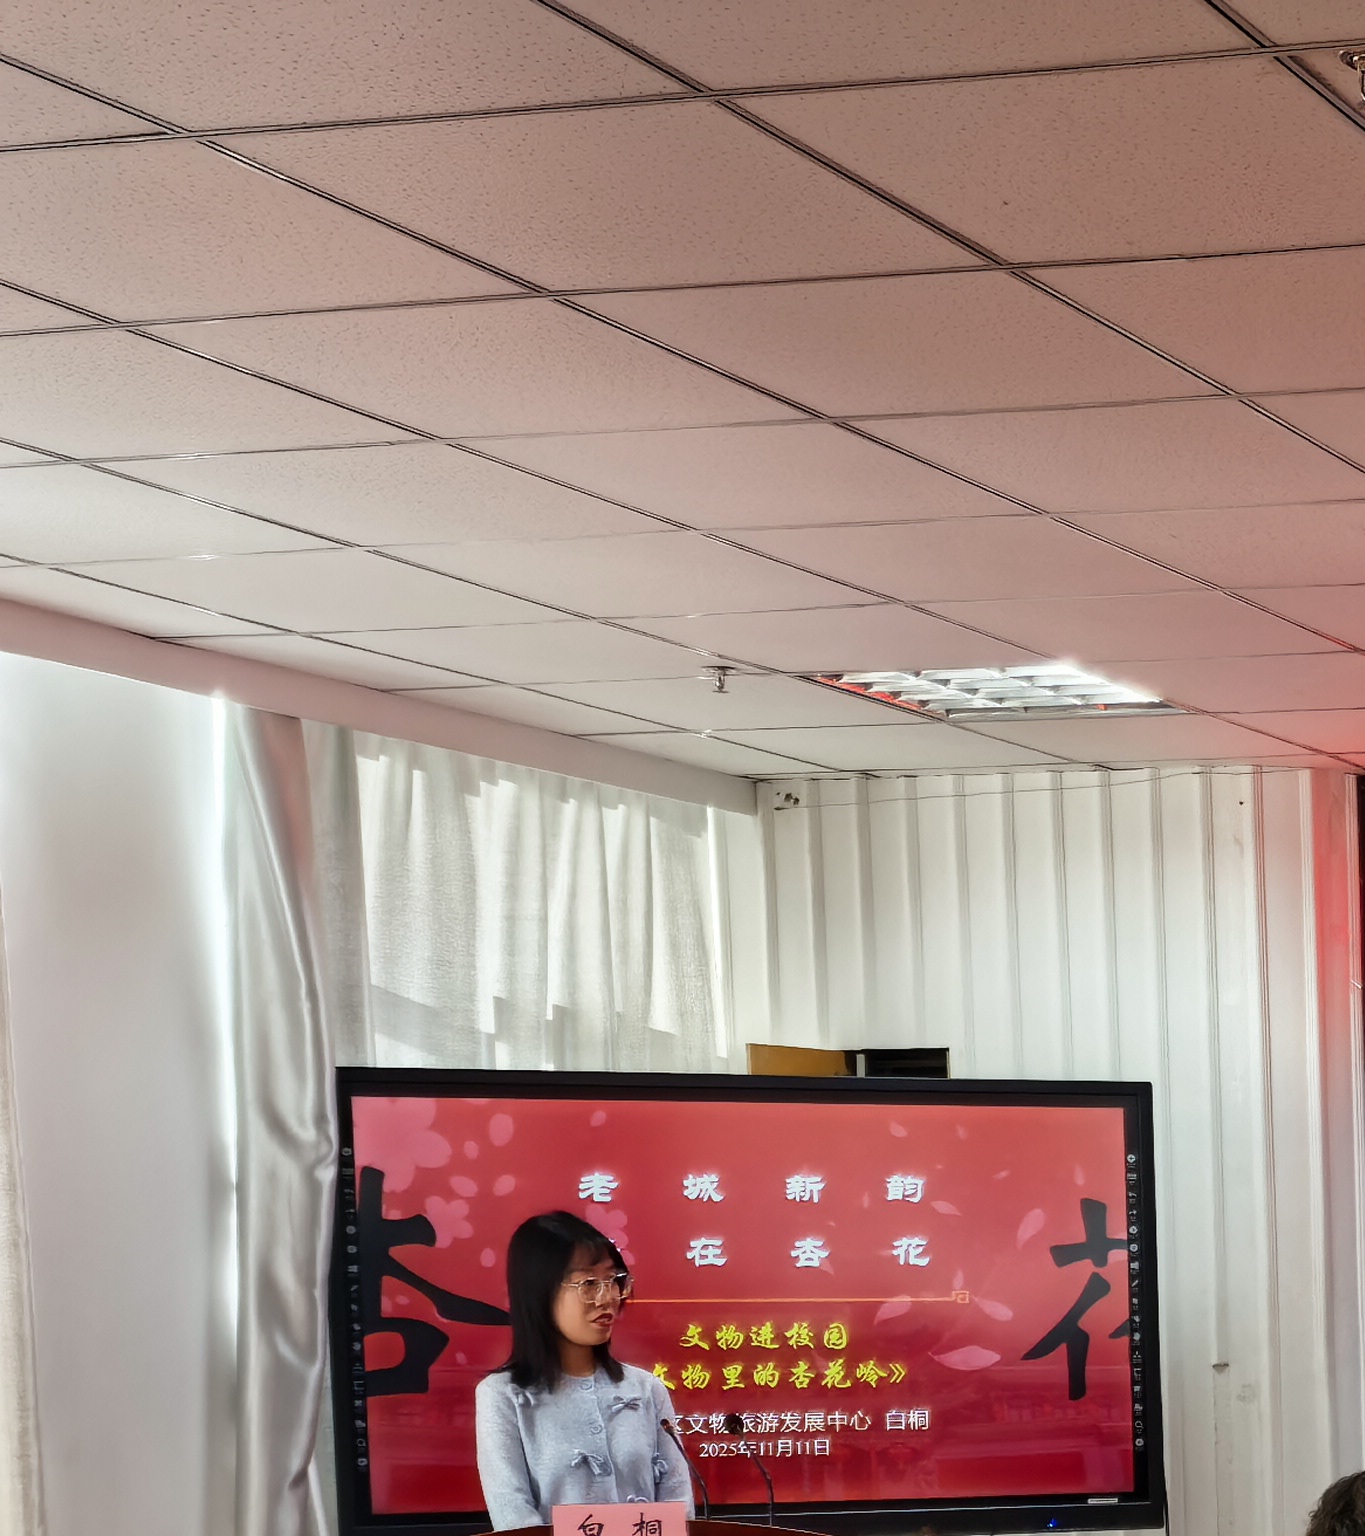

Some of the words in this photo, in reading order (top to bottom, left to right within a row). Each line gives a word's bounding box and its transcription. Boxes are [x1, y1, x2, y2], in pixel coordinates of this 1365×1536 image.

[608, 1237, 930, 1268] 在杏花
[679, 1323, 848, 1350] 文物进校园
[886, 1410, 930, 1431] 白桐
[699, 1439, 831, 1458] 2025年11月11日
